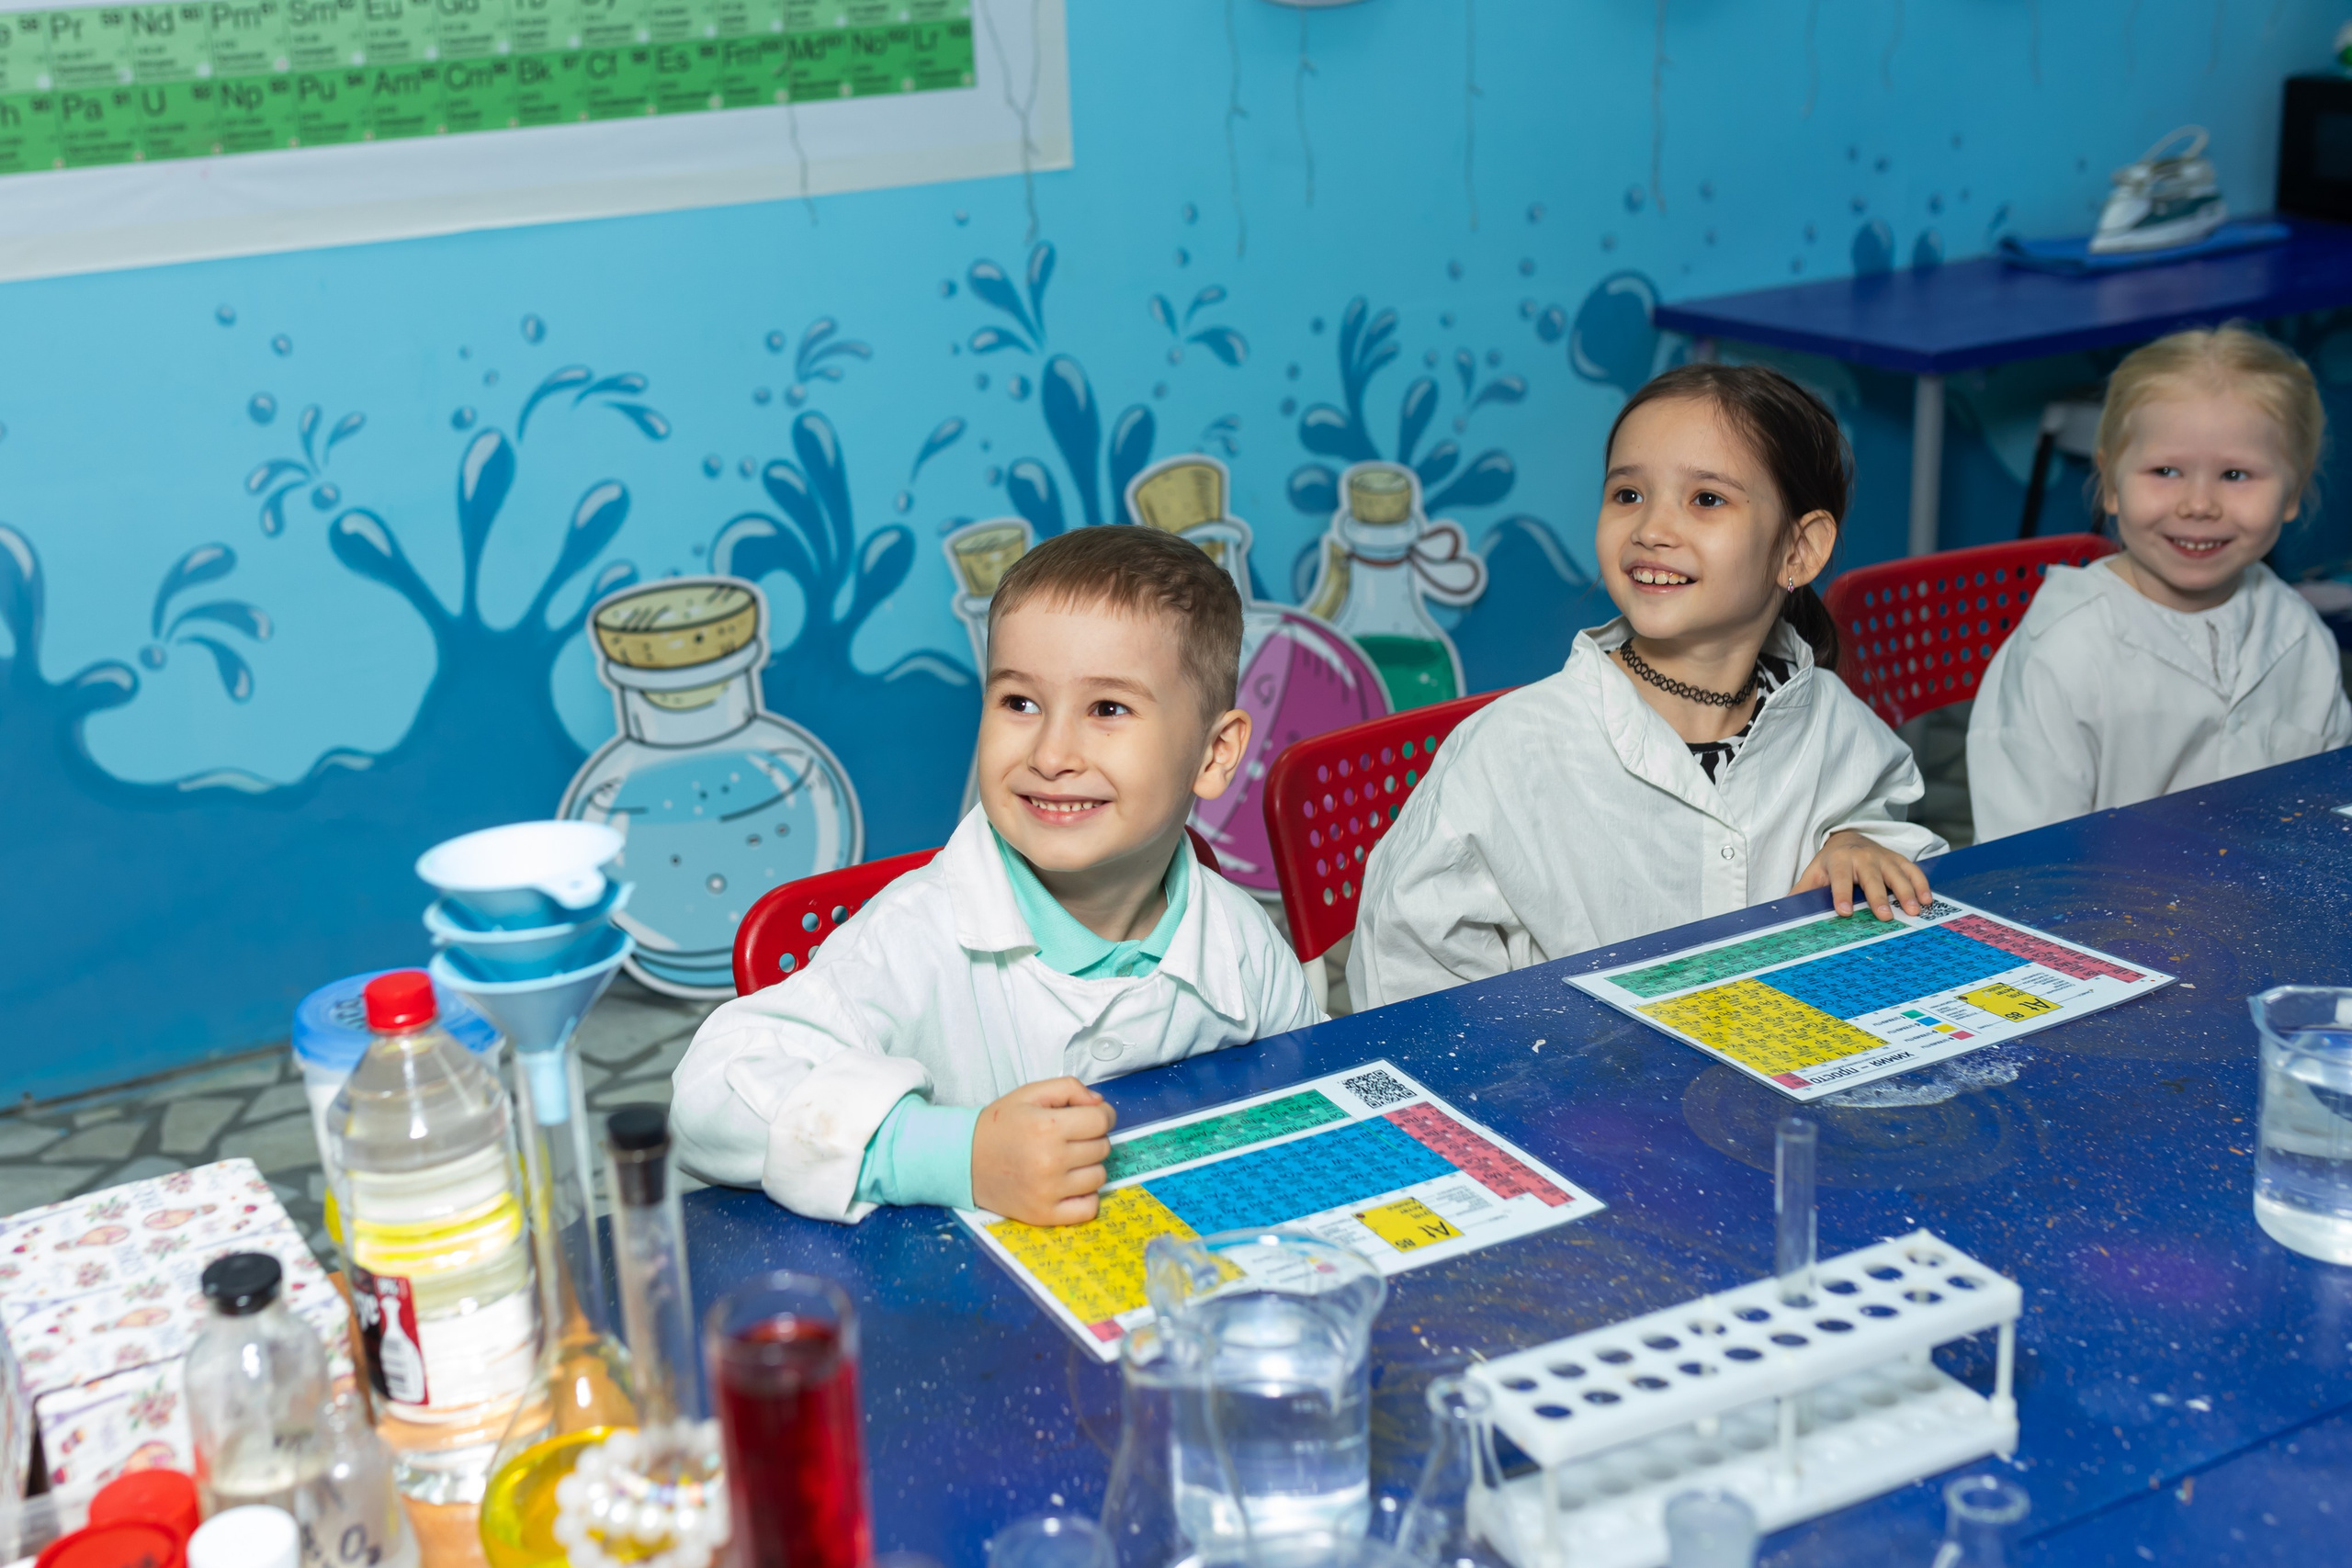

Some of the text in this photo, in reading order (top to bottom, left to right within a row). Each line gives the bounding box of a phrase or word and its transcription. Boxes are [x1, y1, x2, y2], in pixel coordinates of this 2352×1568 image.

[50, 13, 84, 42] Pr
[130, 7, 175, 36] Nd
[211, 4, 261, 31] Pm
[655, 46, 690, 73] Es
[296, 74, 337, 103] Pu
[371, 70, 422, 97] Am
[444, 62, 493, 91] Cm
[61, 94, 104, 122] Pa
[141, 88, 167, 117] U
[219, 80, 264, 111] Np
[2005, 1011, 2024, 1020] 85
[2018, 998, 2050, 1010] At
[1395, 1238, 1415, 1247] 85
[1419, 1221, 1450, 1237] At
